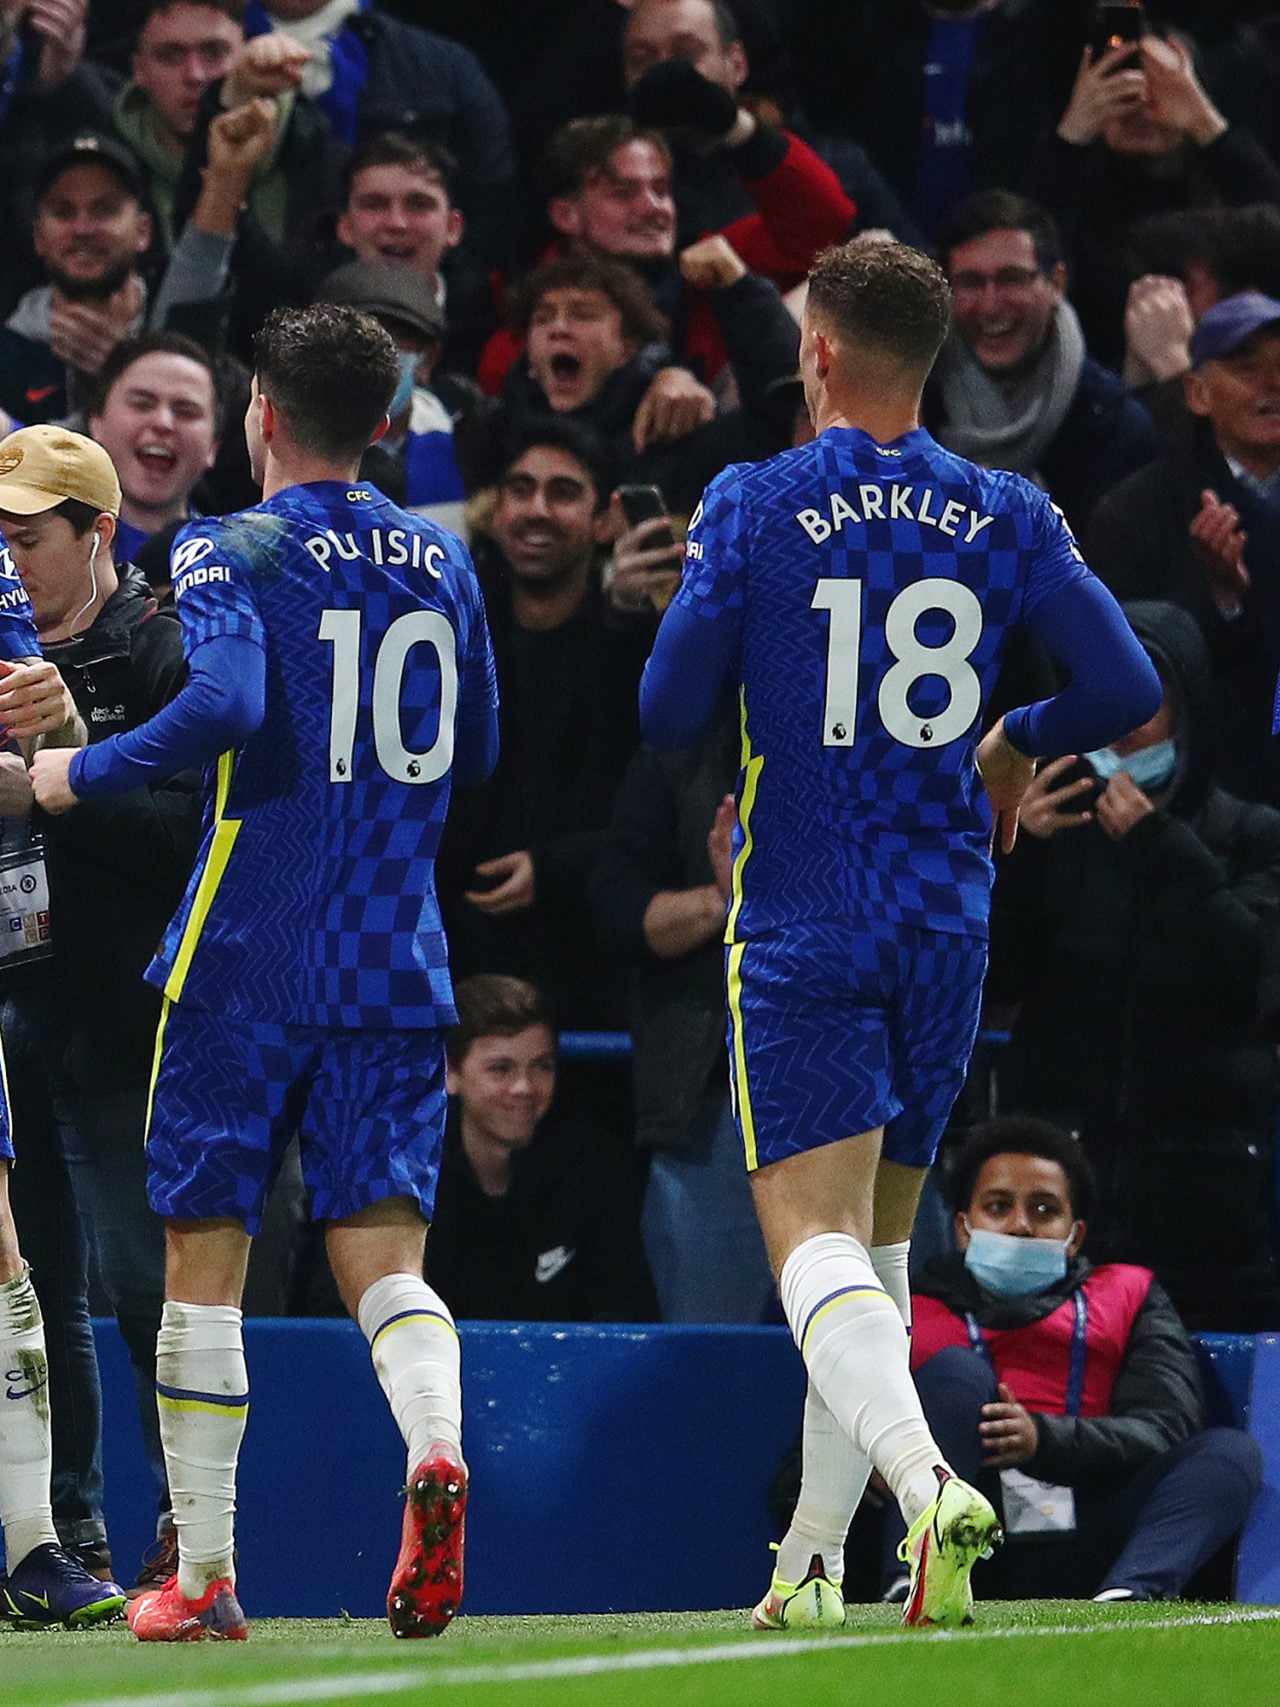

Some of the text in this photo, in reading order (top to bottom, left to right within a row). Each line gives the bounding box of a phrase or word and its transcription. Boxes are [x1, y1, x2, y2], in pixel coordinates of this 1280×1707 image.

[346, 490, 372, 502] CFC
[795, 483, 994, 545] BARKLEY
[304, 528, 446, 579] PUISIC
[810, 577, 983, 748] 18
[318, 609, 459, 784] 10
[5, 1363, 46, 1382] CFC
